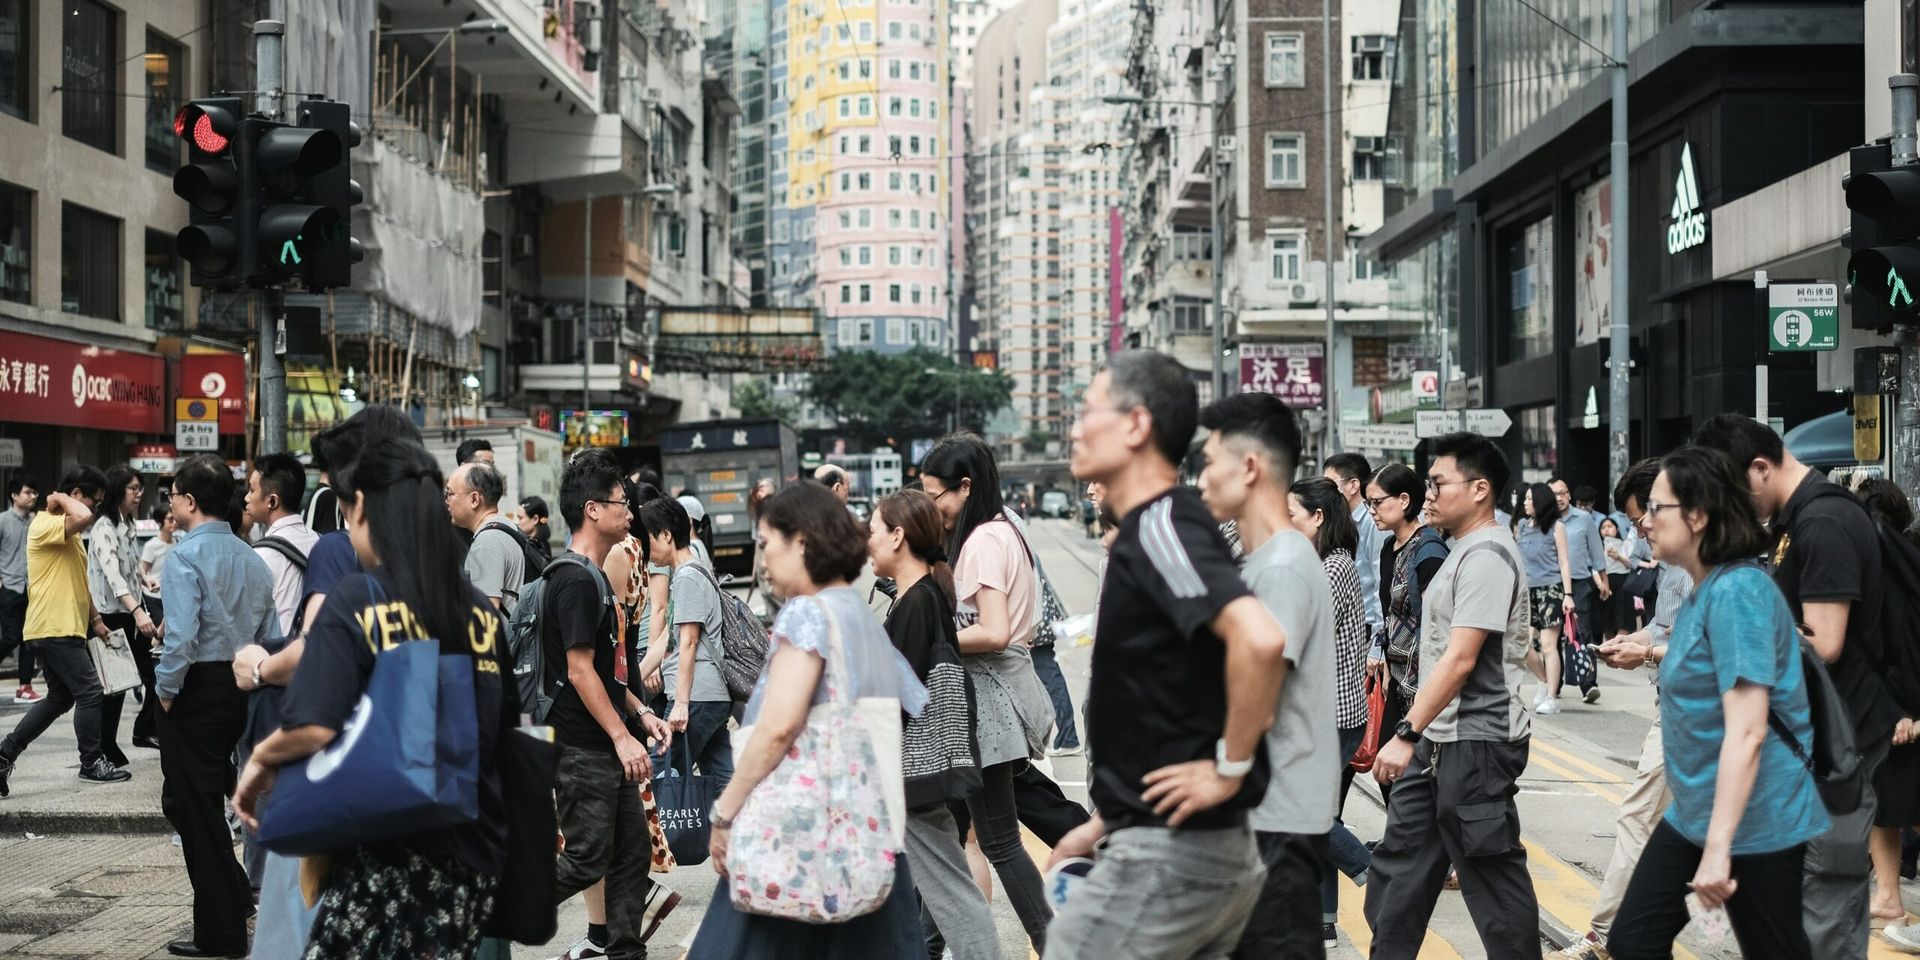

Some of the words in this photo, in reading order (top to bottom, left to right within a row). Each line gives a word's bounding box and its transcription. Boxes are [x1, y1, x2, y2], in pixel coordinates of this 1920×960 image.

[1668, 208, 1705, 254] adidas
[1813, 309, 1834, 317] 56W
[88, 375, 112, 402] OCBC
[112, 379, 136, 404] WING
[138, 382, 161, 407] HANG
[181, 425, 194, 433] 24
[197, 425, 213, 433] hrs
[185, 435, 209, 447] 全日
[660, 808, 700, 819] PEARLY
[660, 818, 702, 830] GATES
